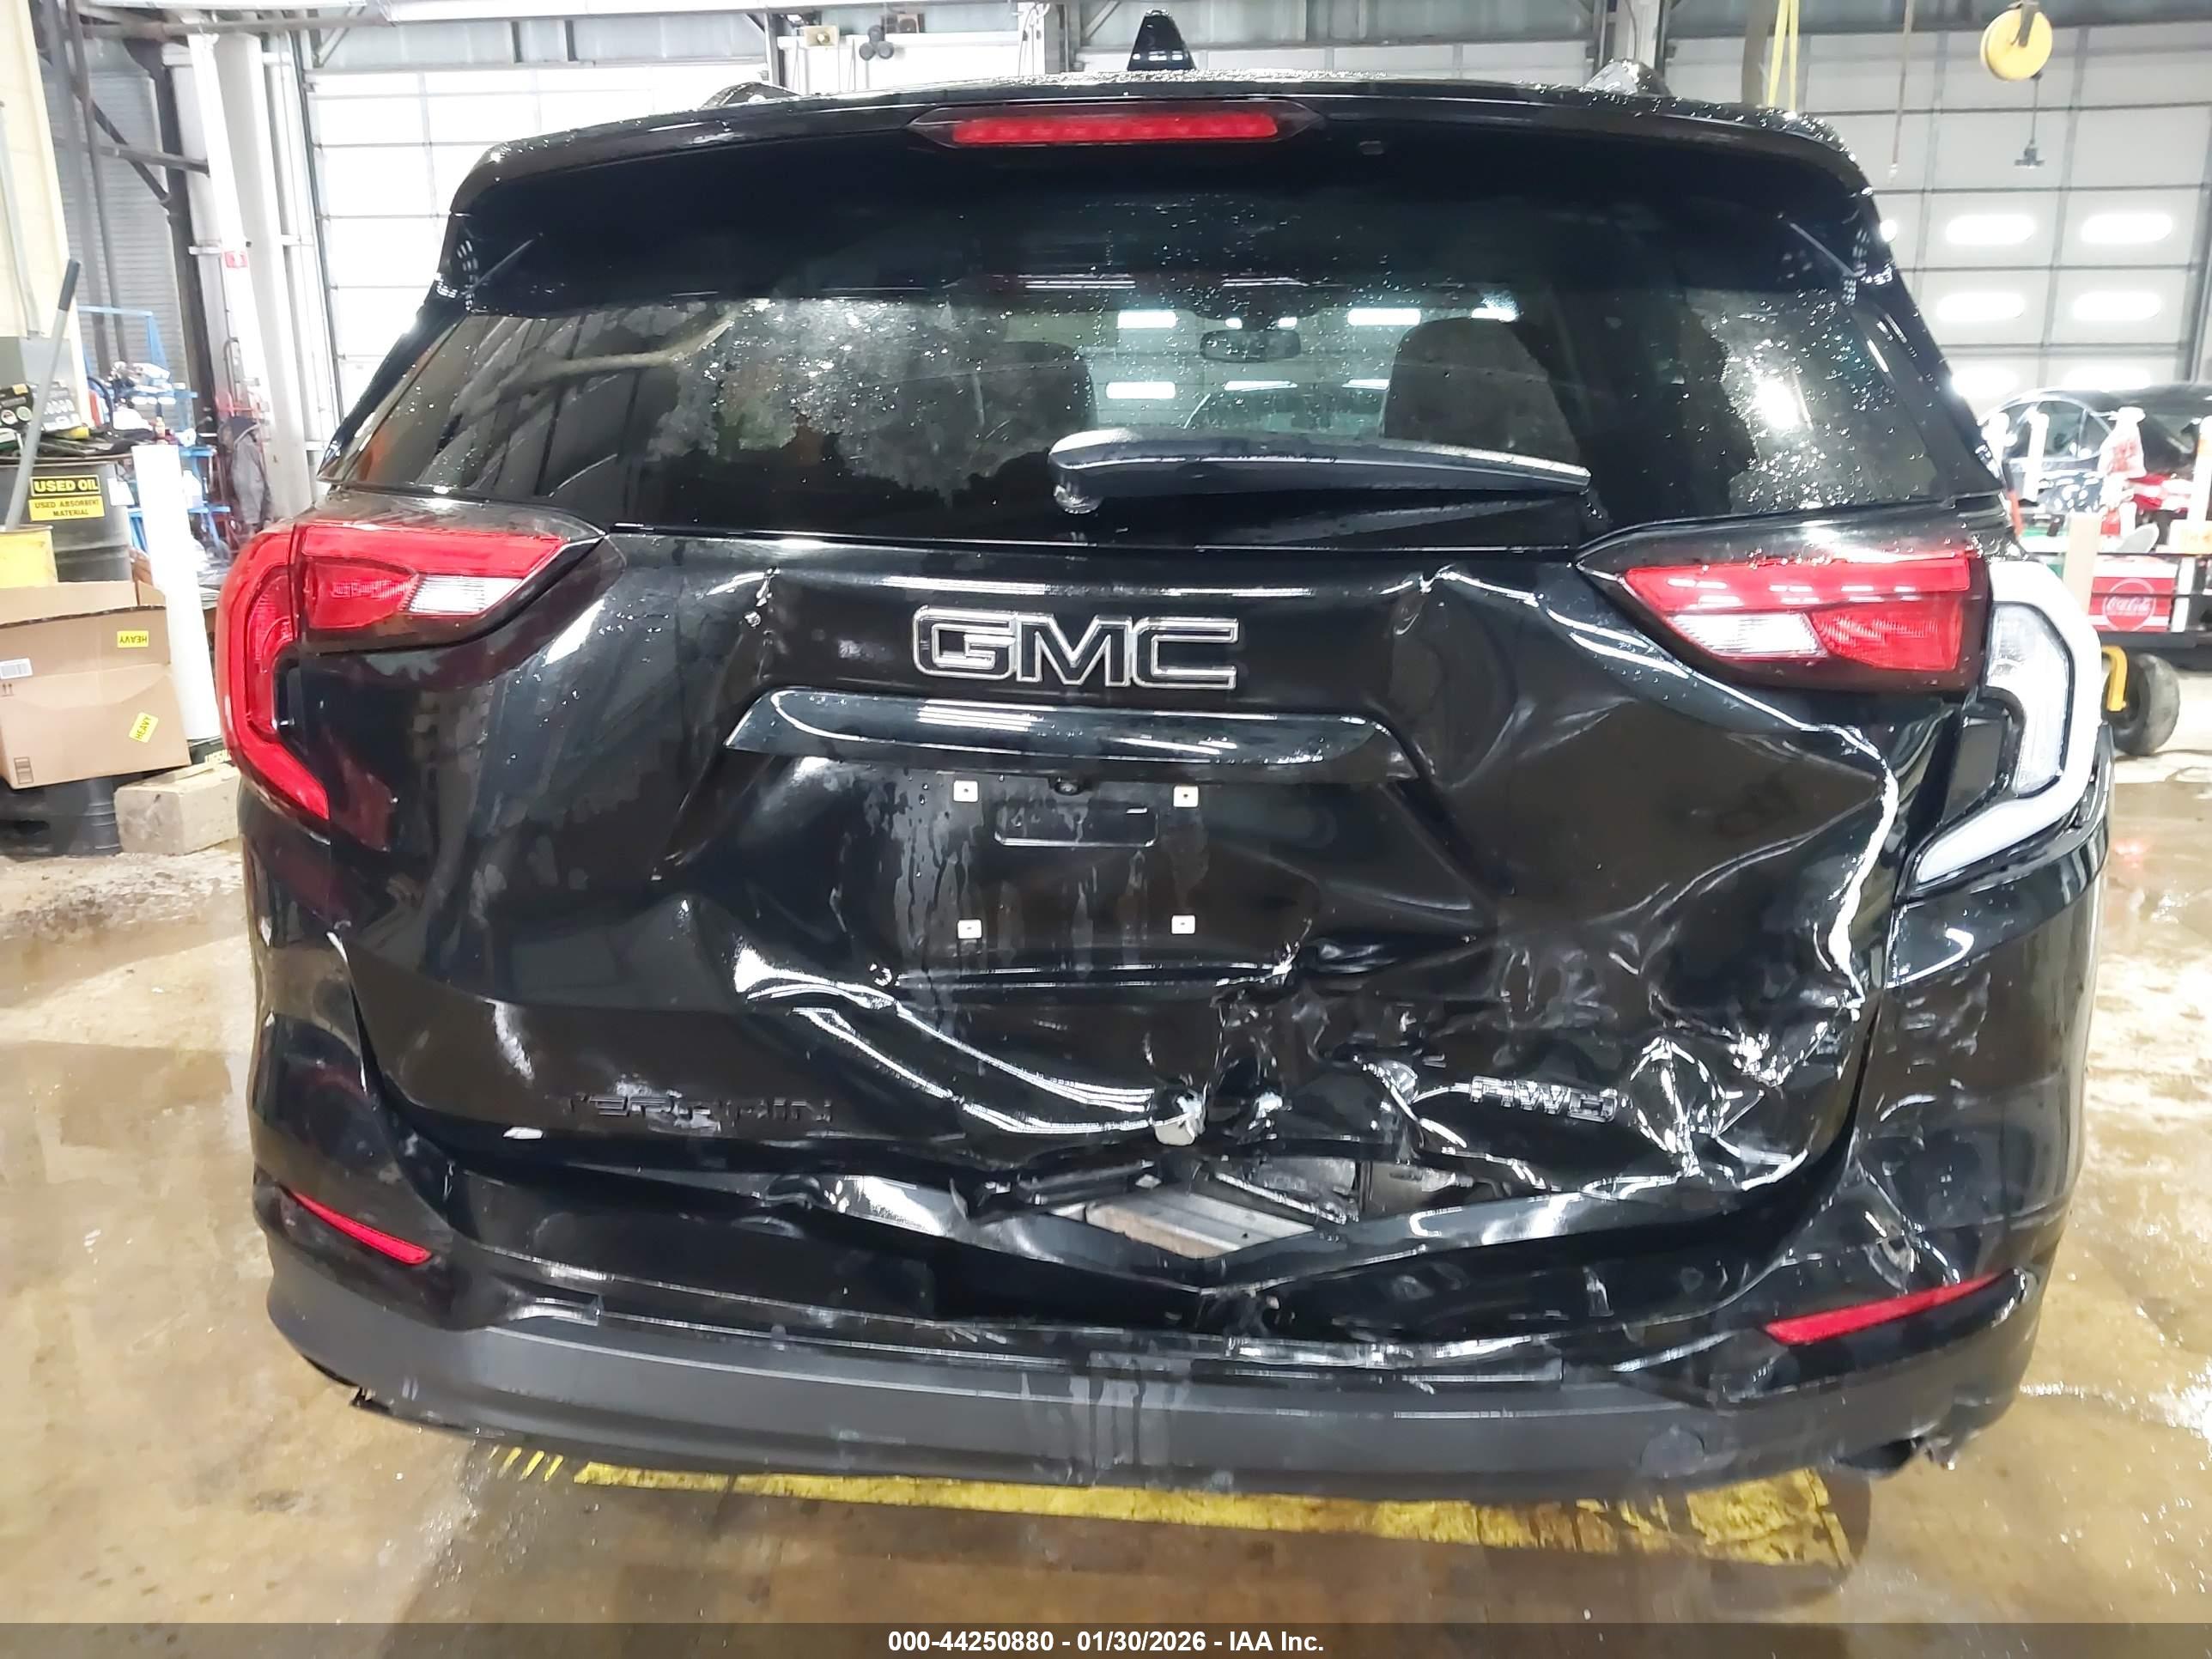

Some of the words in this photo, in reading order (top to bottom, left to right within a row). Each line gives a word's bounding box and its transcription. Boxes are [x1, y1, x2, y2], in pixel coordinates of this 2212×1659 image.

[34, 480, 76, 492] USED
[78, 479, 99, 491] OIL
[59, 499, 100, 507] ABSORBENT
[913, 605, 1239, 690] GMC
[136, 716, 151, 739] HEAVY
